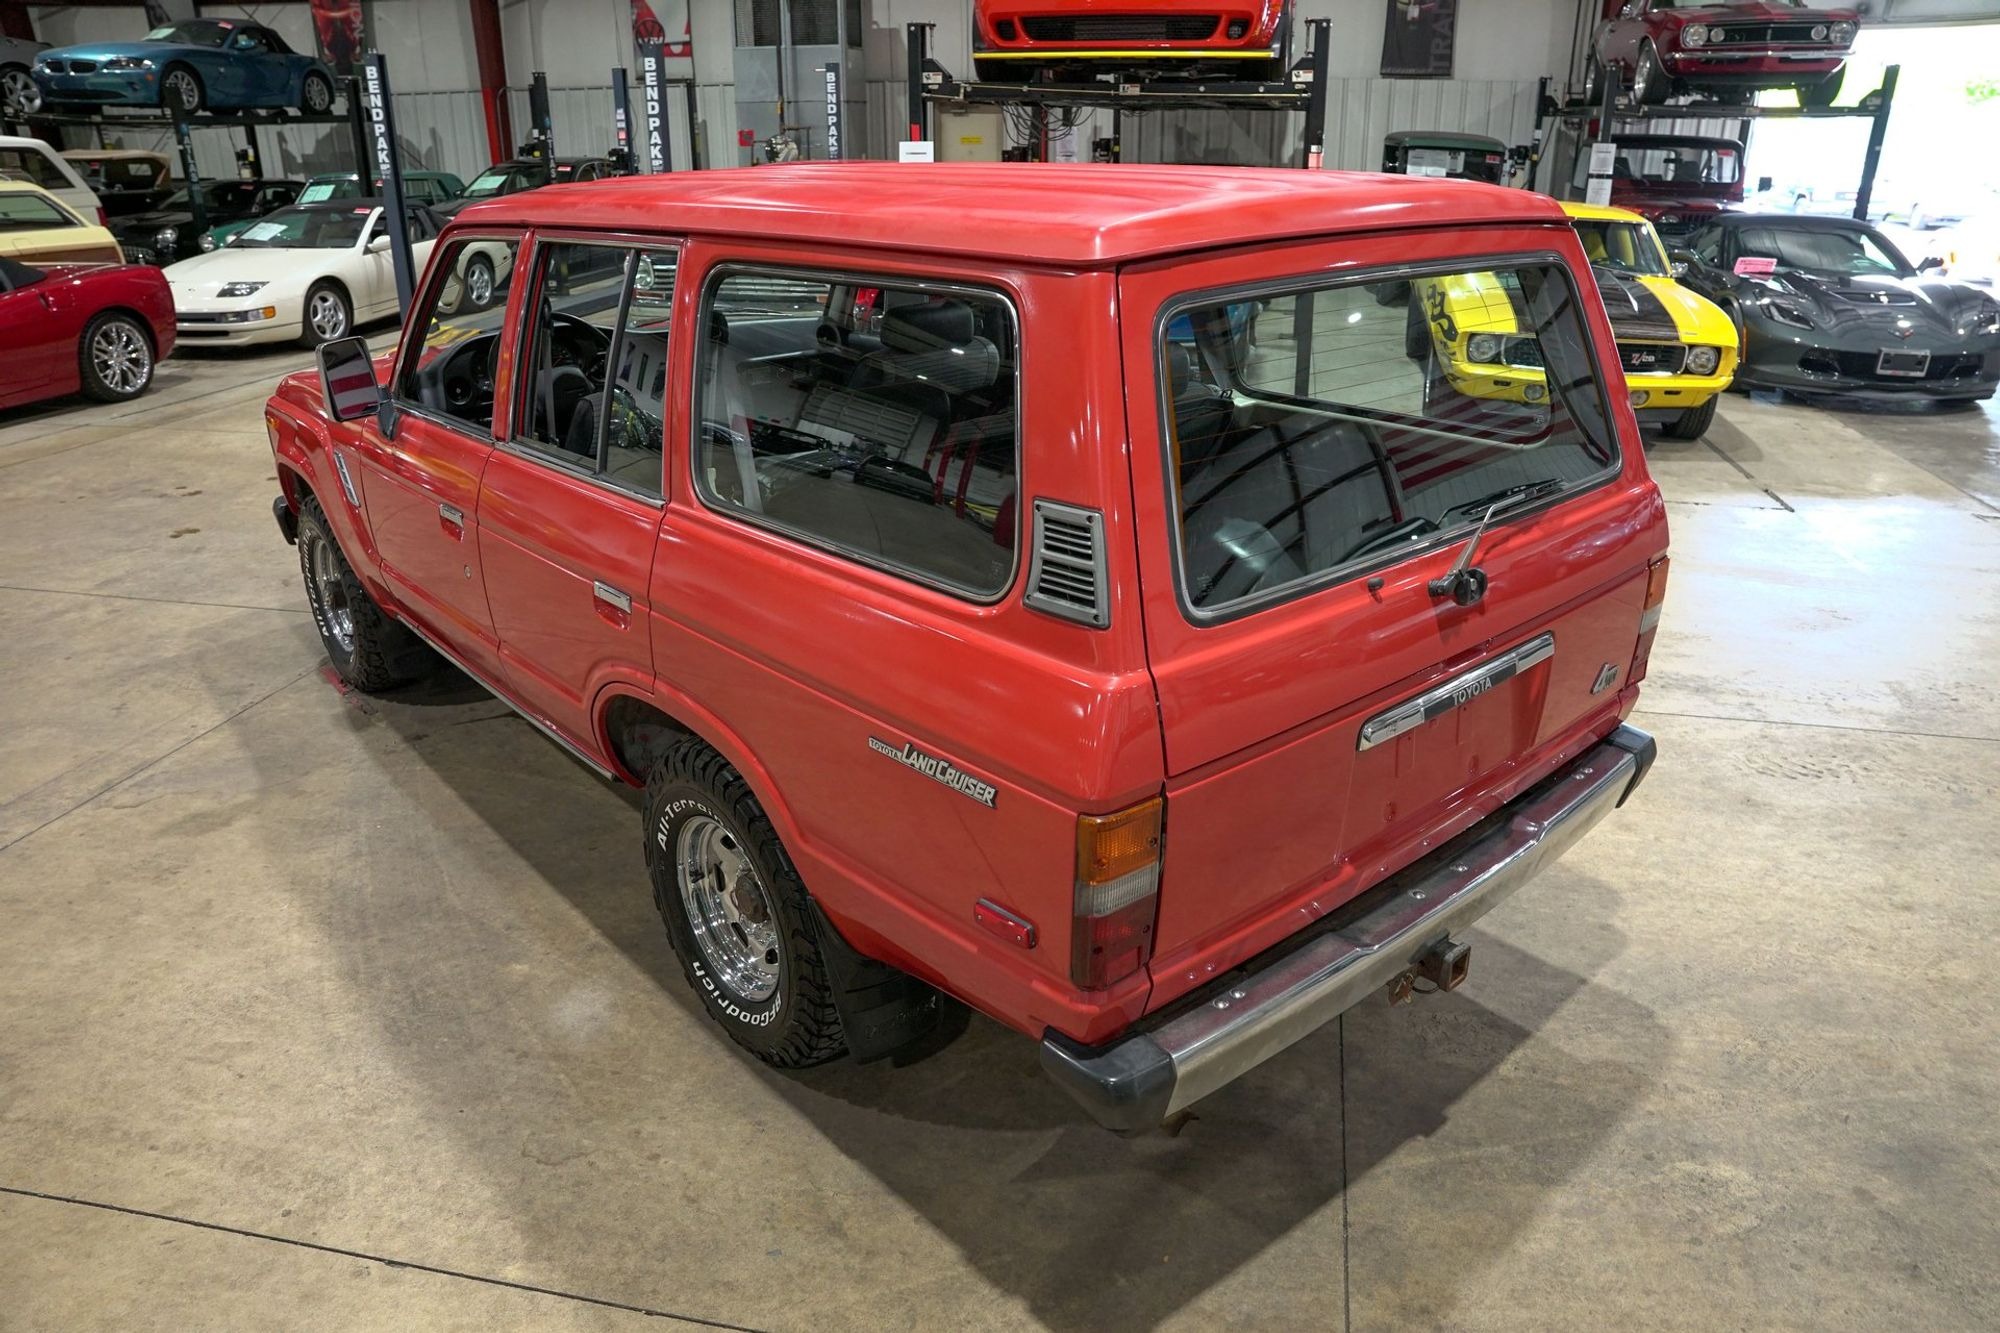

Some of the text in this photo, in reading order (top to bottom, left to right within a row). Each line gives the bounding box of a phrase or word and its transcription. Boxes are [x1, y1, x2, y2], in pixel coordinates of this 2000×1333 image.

[365, 66, 391, 163] BENDPAK
[644, 57, 662, 158] BENDPAK
[826, 72, 838, 146] BENDPAK
[1452, 676, 1492, 706] TOYOTA
[869, 738, 901, 761] TOYOTA
[693, 961, 782, 1027] BFGoodrich
